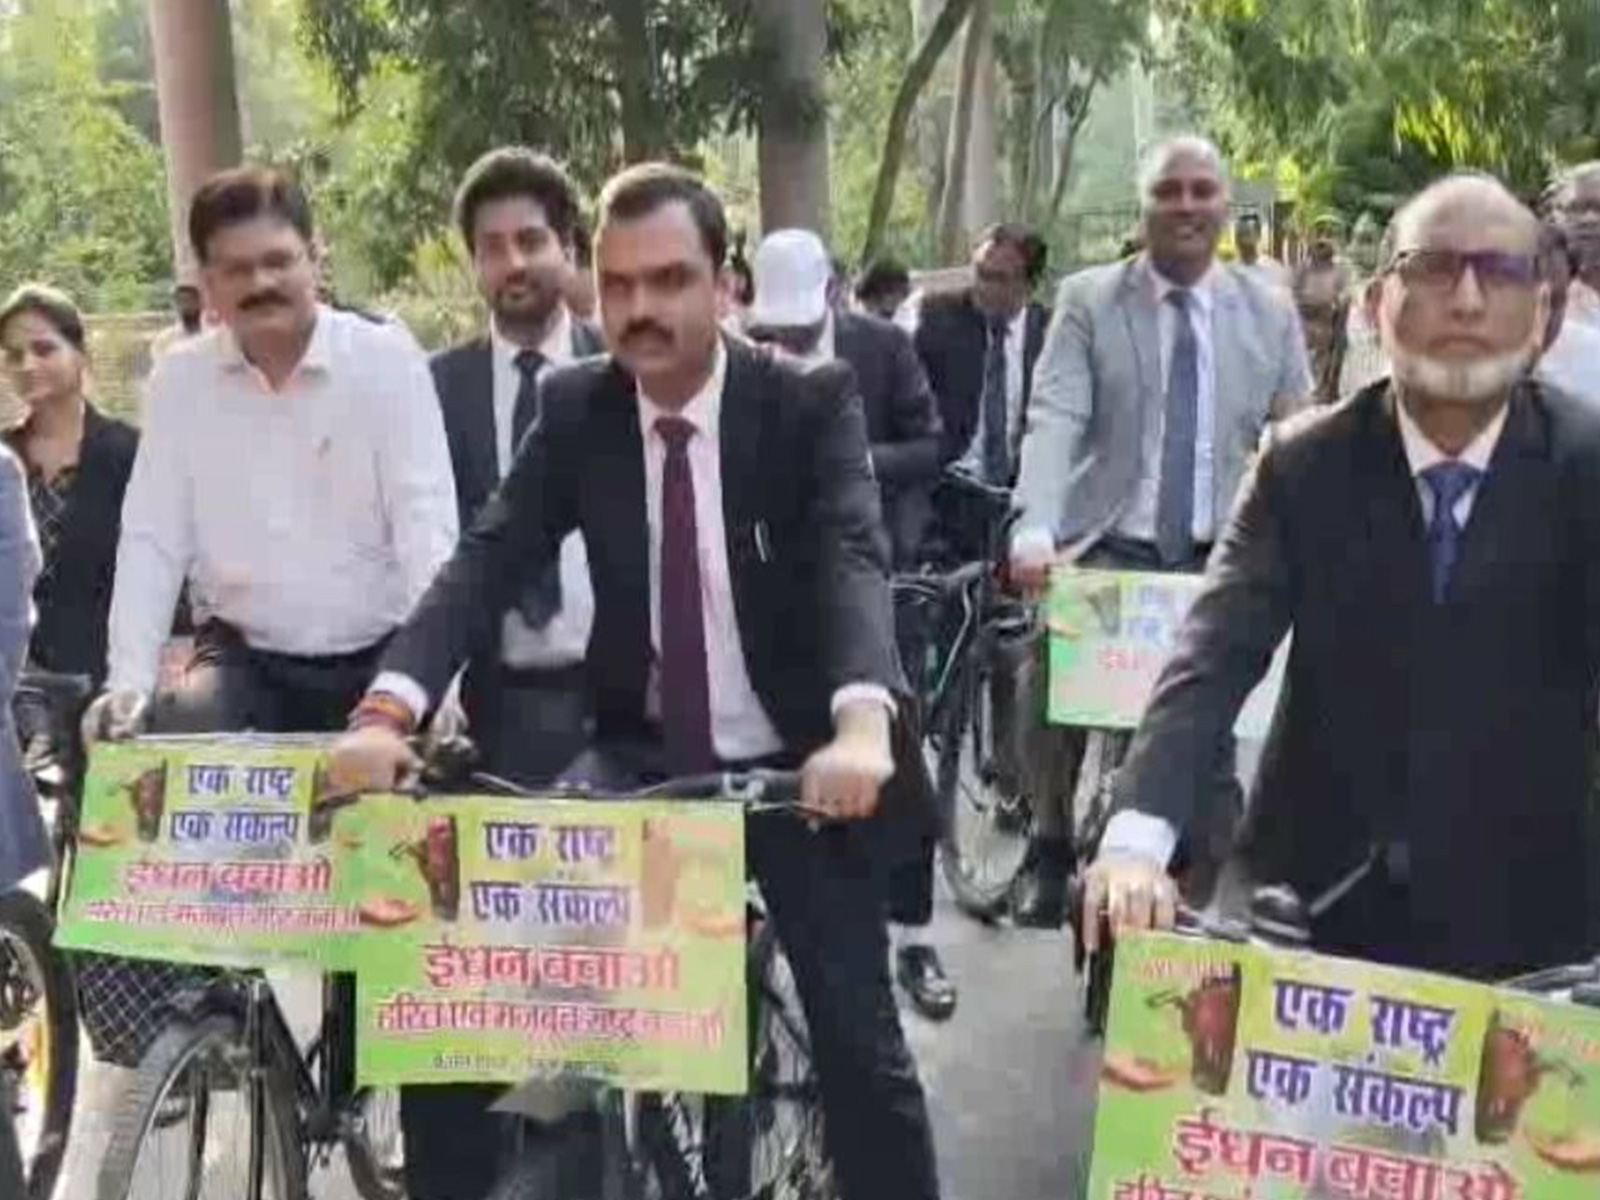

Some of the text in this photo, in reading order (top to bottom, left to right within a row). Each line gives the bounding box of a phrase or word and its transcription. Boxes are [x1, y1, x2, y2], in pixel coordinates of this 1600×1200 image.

[483, 821, 540, 860] एक
[470, 880, 521, 921] एक
[1273, 979, 1354, 1034] एक
[1370, 996, 1456, 1066] राष्ट्र
[1247, 1050, 1467, 1136] एक संकल्प
